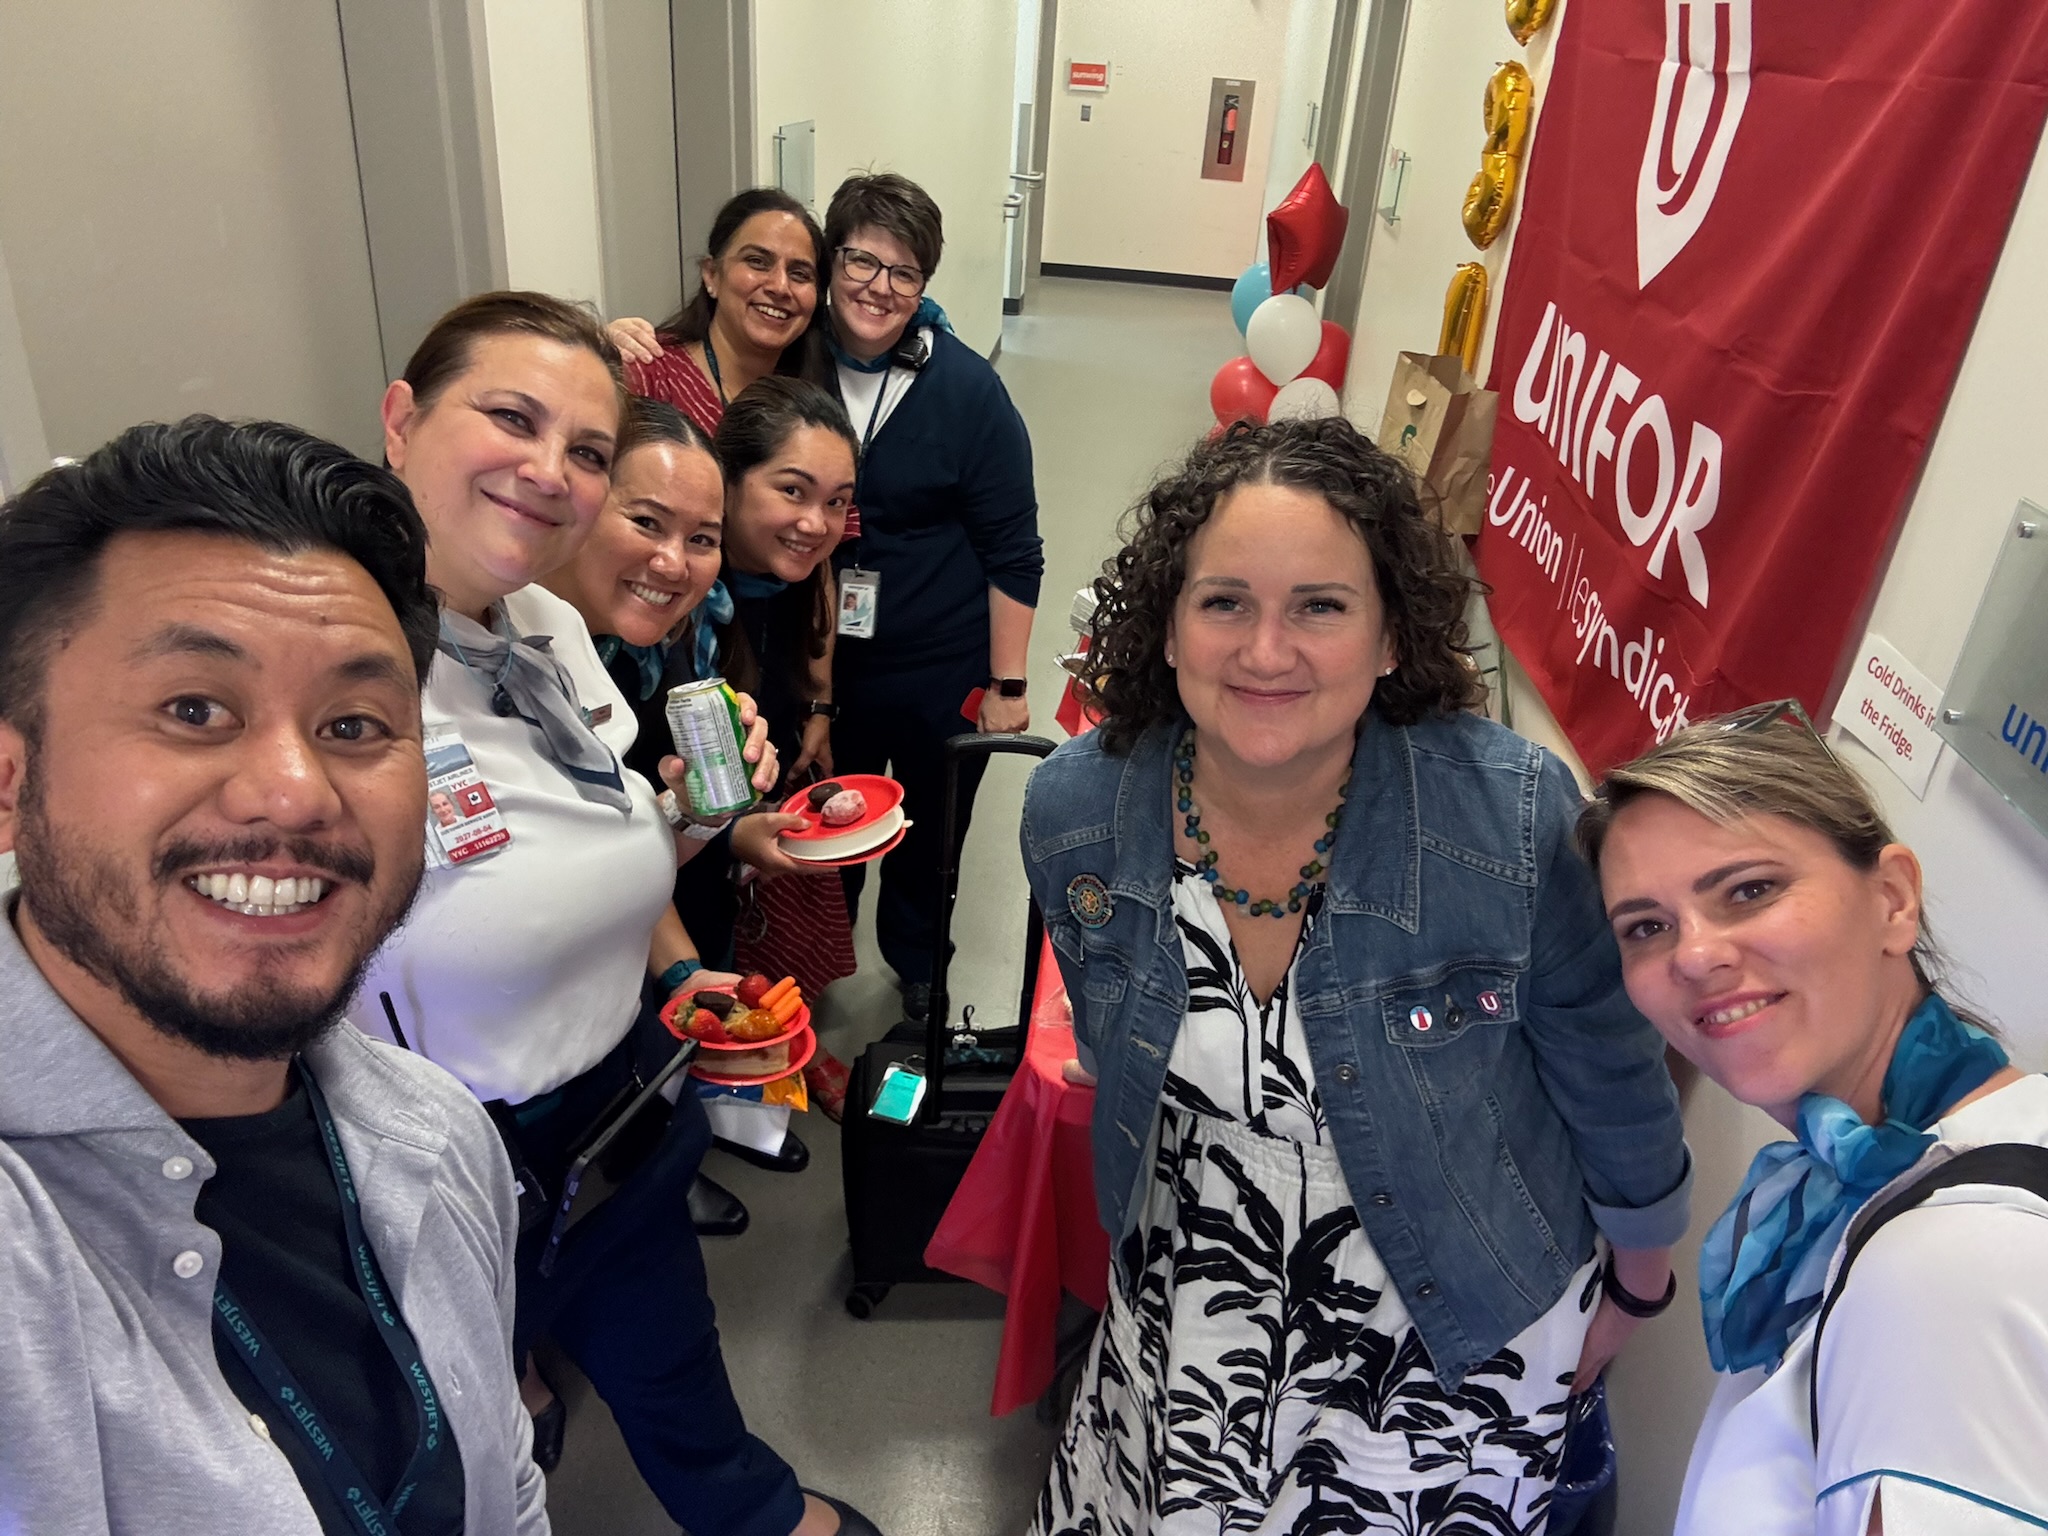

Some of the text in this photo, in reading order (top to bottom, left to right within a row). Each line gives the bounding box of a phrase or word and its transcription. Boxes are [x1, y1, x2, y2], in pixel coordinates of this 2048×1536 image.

[1867, 656, 1896, 689] Cold
[1891, 676, 1927, 720] Drinks
[1860, 698, 1913, 761] the Fridge.
[325, 1120, 349, 1183] WESTJET
[358, 1244, 388, 1308] WESTJET
[214, 1294, 261, 1357] WESTJET
[410, 1361, 438, 1432] WESTJET
[290, 1401, 334, 1461] WESTJET
